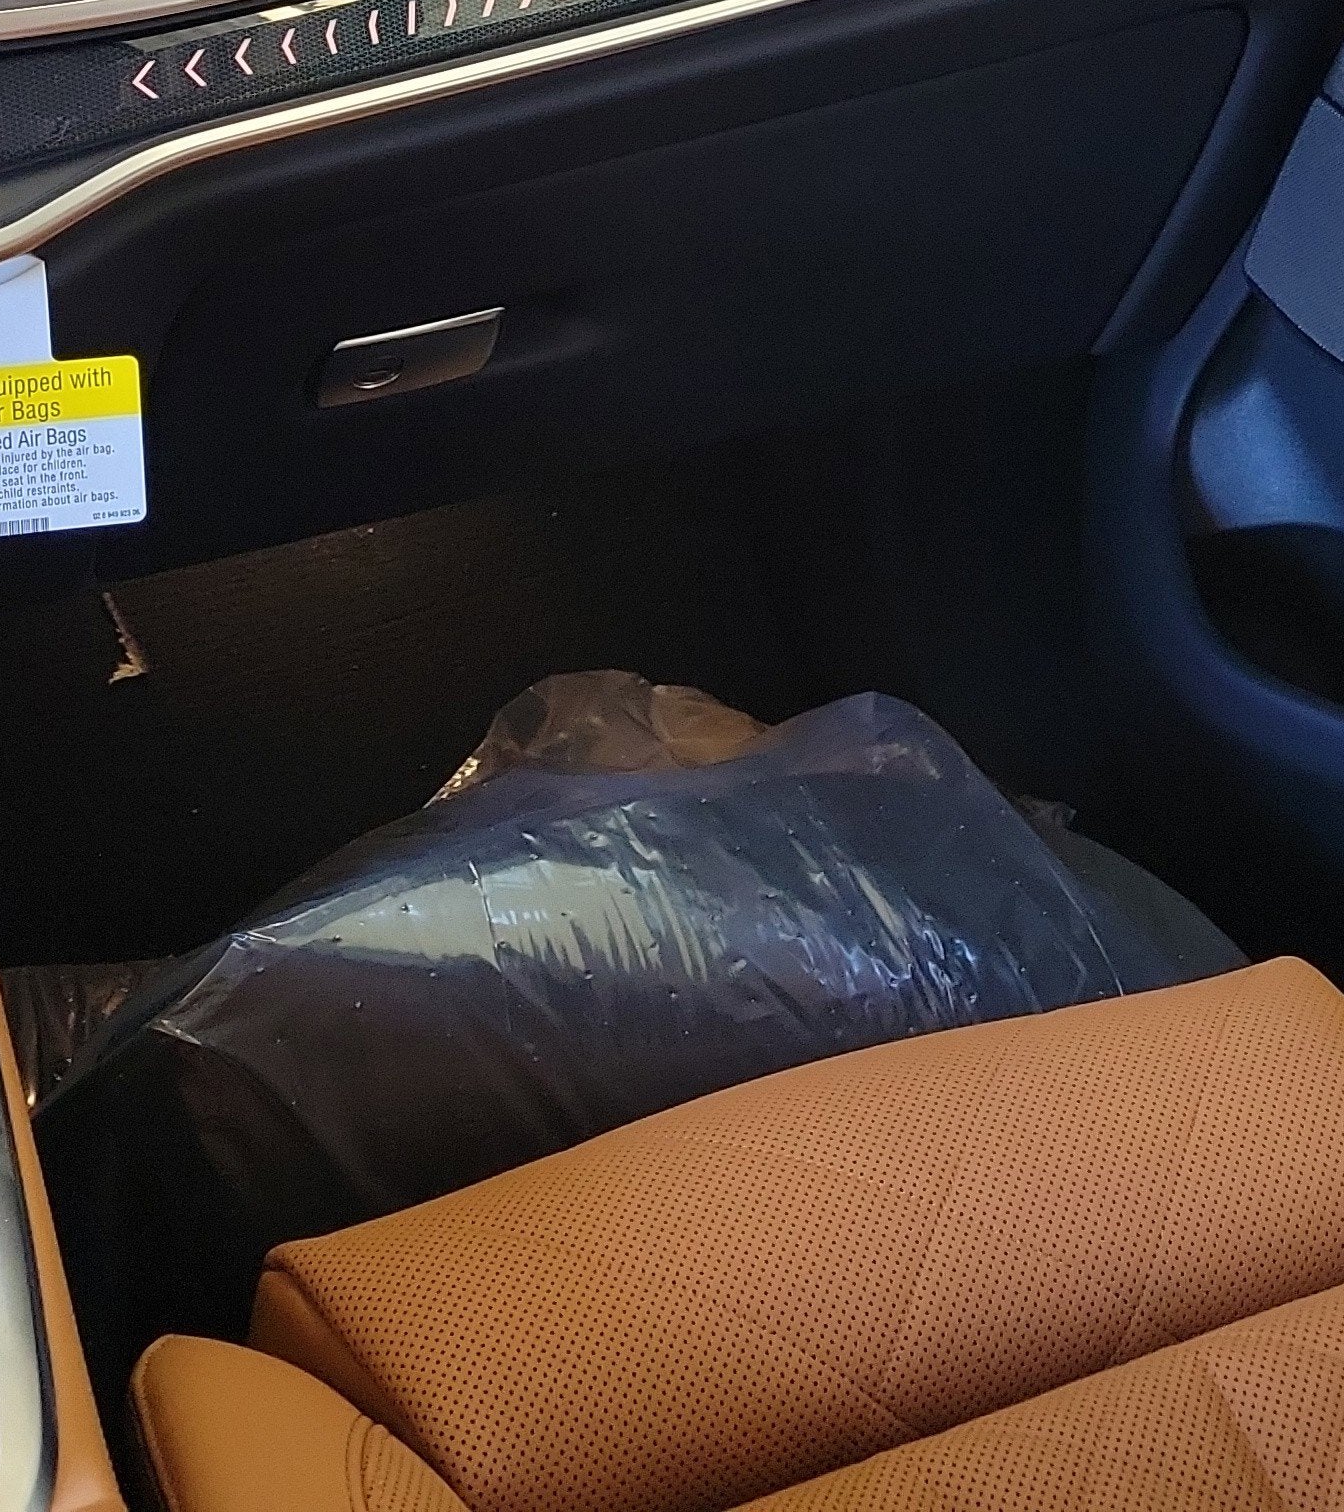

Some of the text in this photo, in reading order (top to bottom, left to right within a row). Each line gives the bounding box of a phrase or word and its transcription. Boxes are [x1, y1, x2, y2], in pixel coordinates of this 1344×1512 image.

[69, 367, 112, 389] with
[12, 400, 62, 423] Bags
[17, 429, 42, 449] Air
[46, 427, 87, 447] Bags
[1, 451, 37, 465] injured
[41, 449, 53, 462] by
[56, 447, 73, 459] the
[76, 445, 90, 457] air
[93, 443, 115, 456] bag.
[23, 461, 38, 473] for
[41, 458, 87, 472] children.
[2, 476, 24, 487] seat
[27, 474, 37, 485] in
[40, 472, 57, 485] the
[59, 469, 88, 481] front.
[26, 482, 80, 498] restraints.
[41, 495, 71, 507] about
[74, 492, 88, 504] air
[91, 490, 119, 503] bags.
